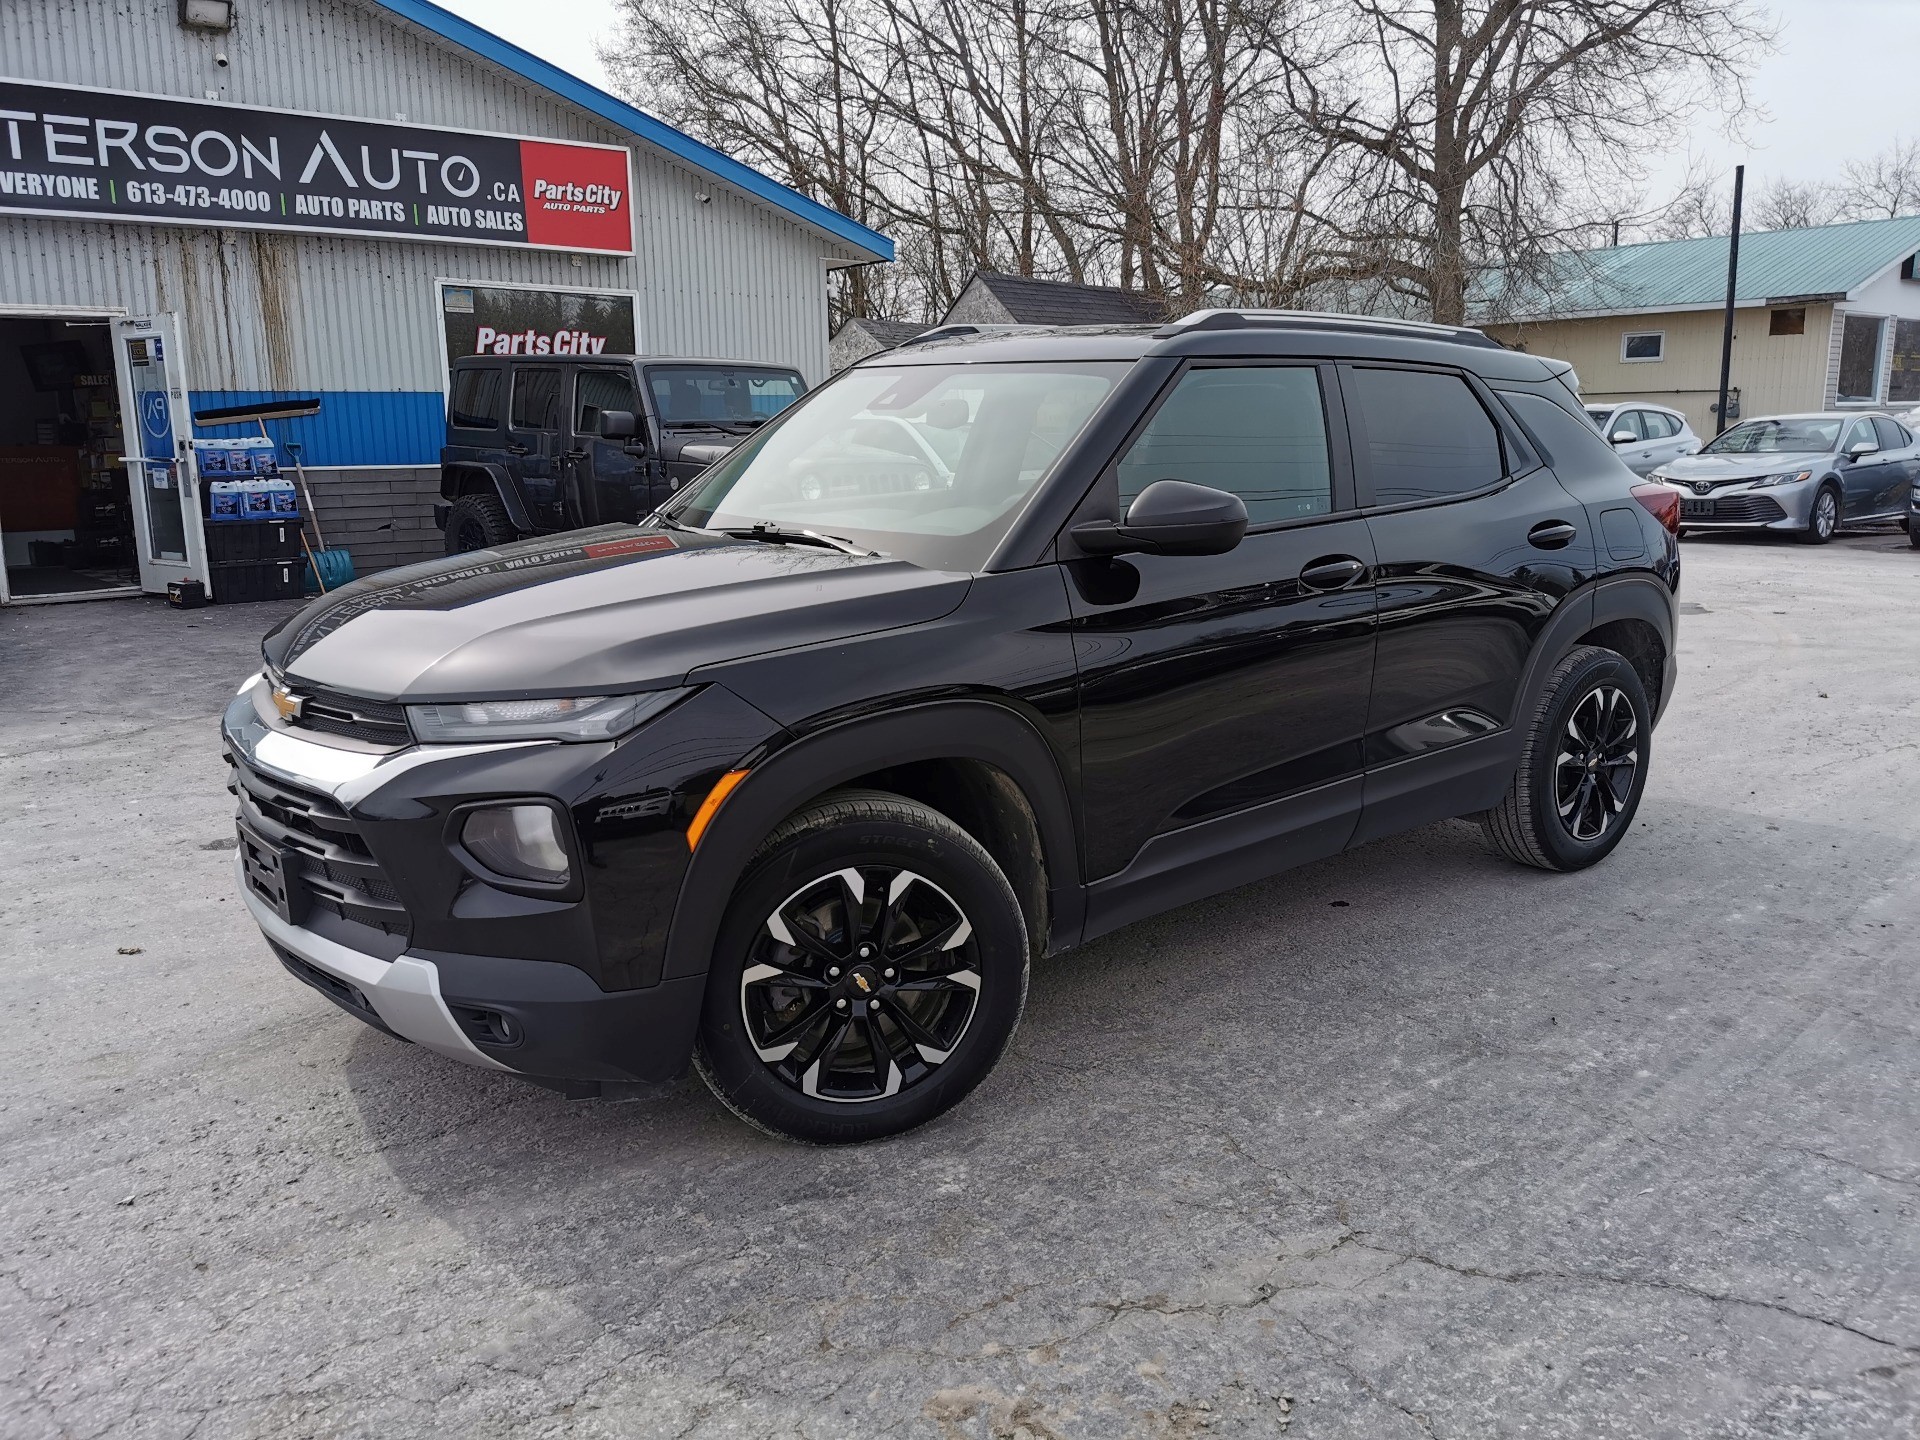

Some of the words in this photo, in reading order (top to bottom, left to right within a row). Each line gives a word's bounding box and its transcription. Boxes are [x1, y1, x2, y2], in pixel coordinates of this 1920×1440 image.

[126, 180, 271, 213] 613-473-4000
[295, 194, 344, 218] AUTO
[348, 199, 406, 223] PARTS
[427, 204, 472, 228] AUTO
[475, 209, 524, 232] SALES
[542, 201, 571, 212] AUTO
[573, 203, 606, 214] PARTS
[80, 374, 110, 386] SALES
